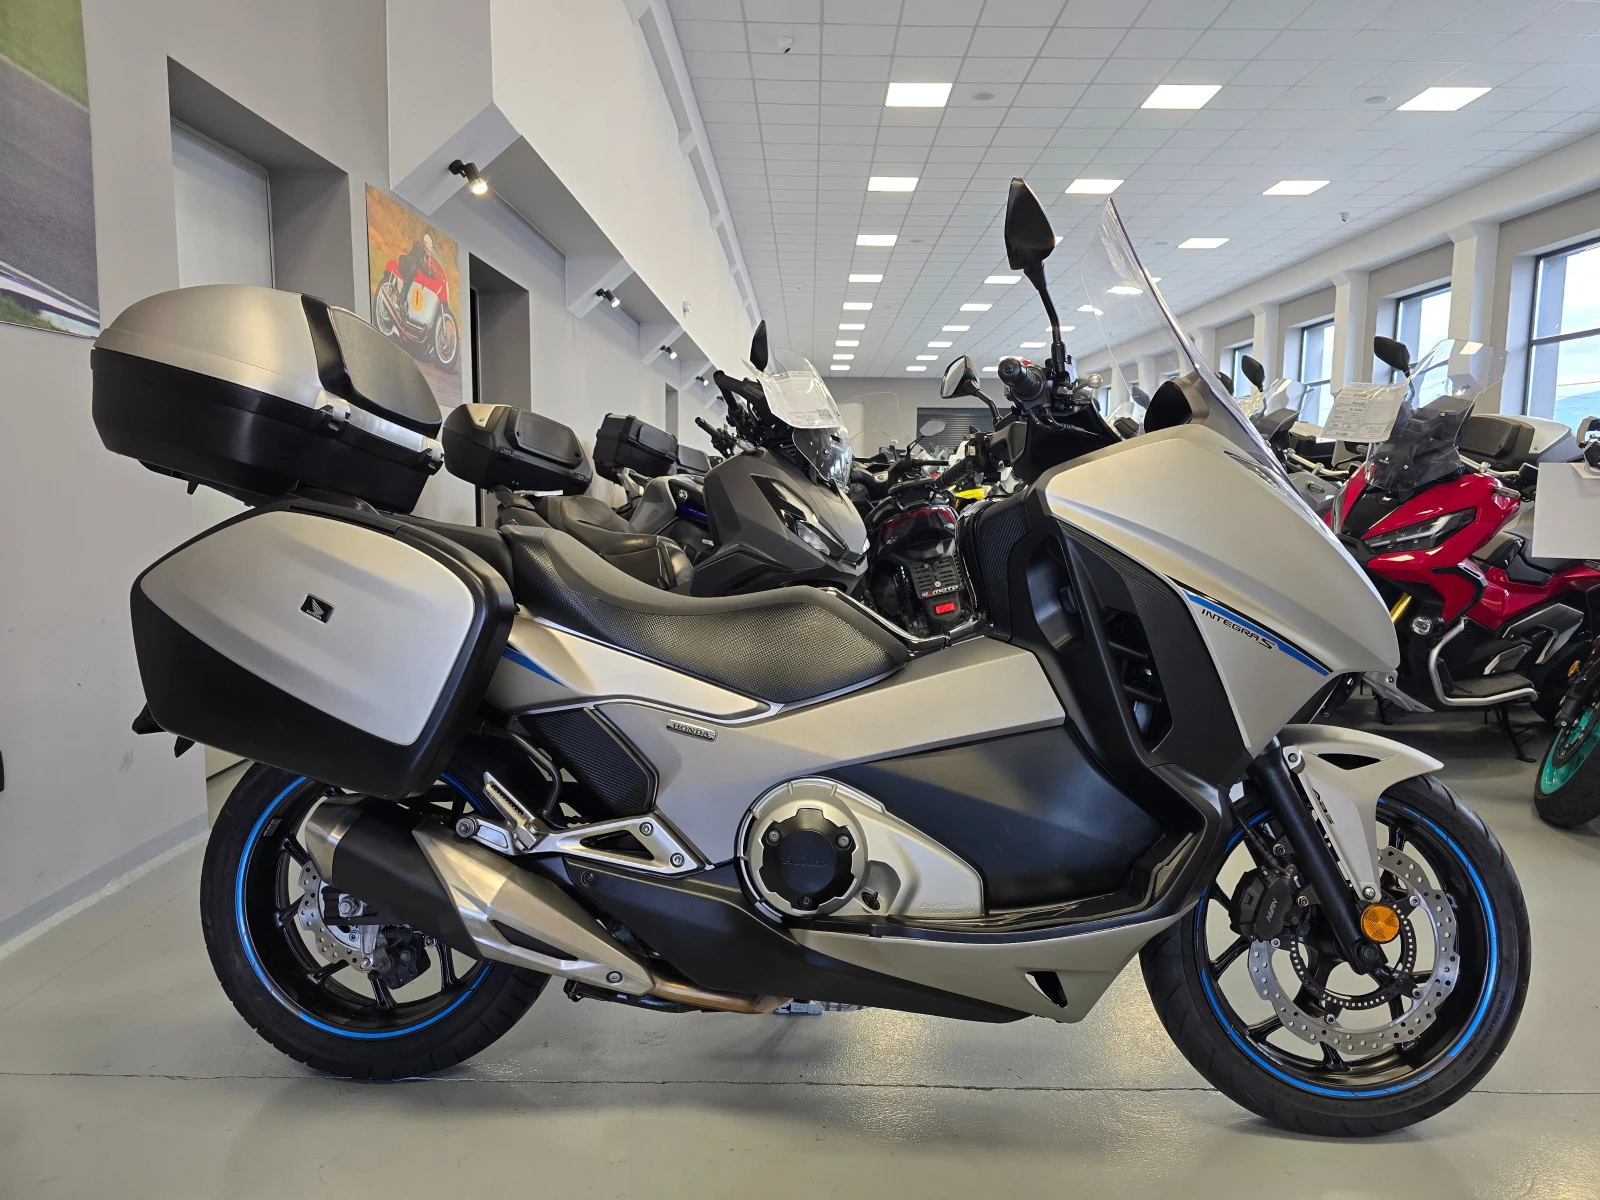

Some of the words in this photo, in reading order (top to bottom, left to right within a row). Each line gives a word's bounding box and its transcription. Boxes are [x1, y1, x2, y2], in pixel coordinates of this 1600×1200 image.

[1201, 608, 1260, 642] INTEGRA
[1257, 638, 1276, 650] S
[671, 722, 710, 738] HONDA
